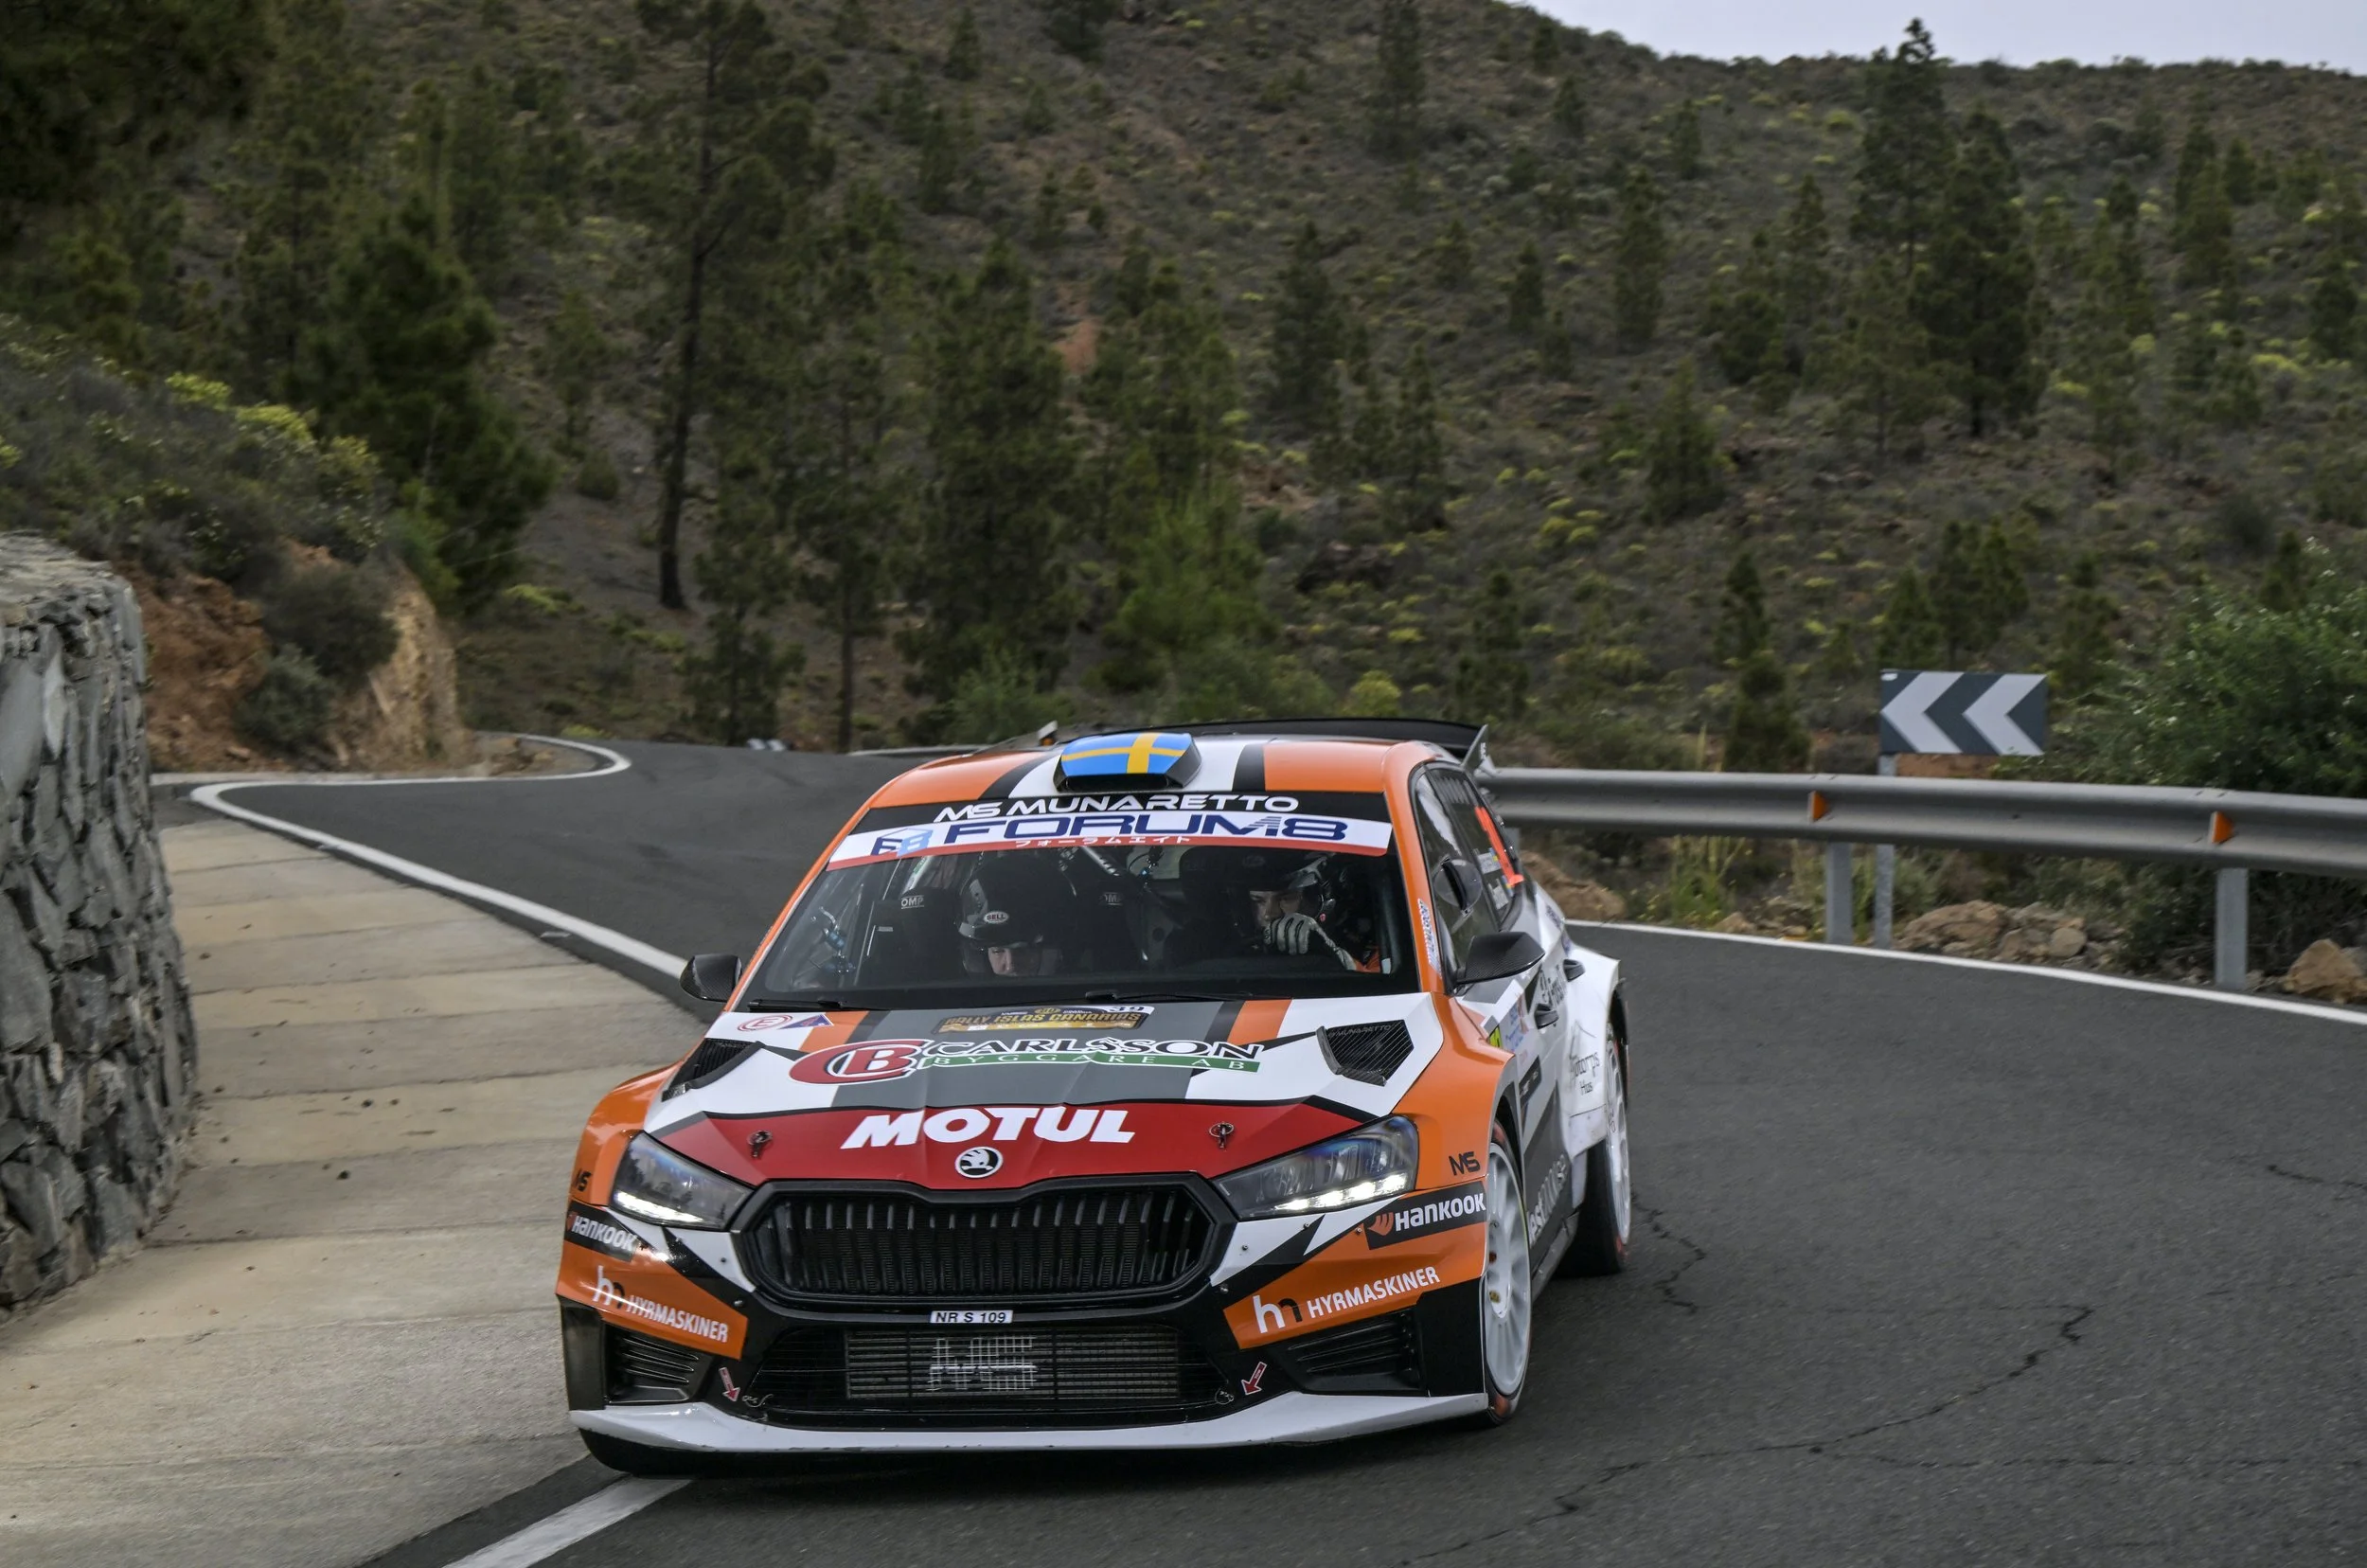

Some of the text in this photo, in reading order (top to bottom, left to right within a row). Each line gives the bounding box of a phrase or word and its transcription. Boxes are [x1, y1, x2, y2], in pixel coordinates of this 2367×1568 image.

[934, 793, 1299, 823] MS MUNARETTO
[944, 813, 1347, 845] FORUM8
[900, 896, 924, 908] OMP
[986, 913, 1006, 921] BELL
[945, 1013, 1141, 1025] RALLY ISLAS CANARIAS
[923, 1037, 1264, 1060] CARLSSON
[934, 1052, 1244, 1070] BYGGARE AB
[840, 1106, 1135, 1149] MOTUL
[1449, 1151, 1480, 1175] MS
[1307, 1266, 1440, 1318] HYRMASKINER
[626, 1294, 728, 1343] HYRMASKINER
[935, 1312, 1006, 1323] NR S 109
